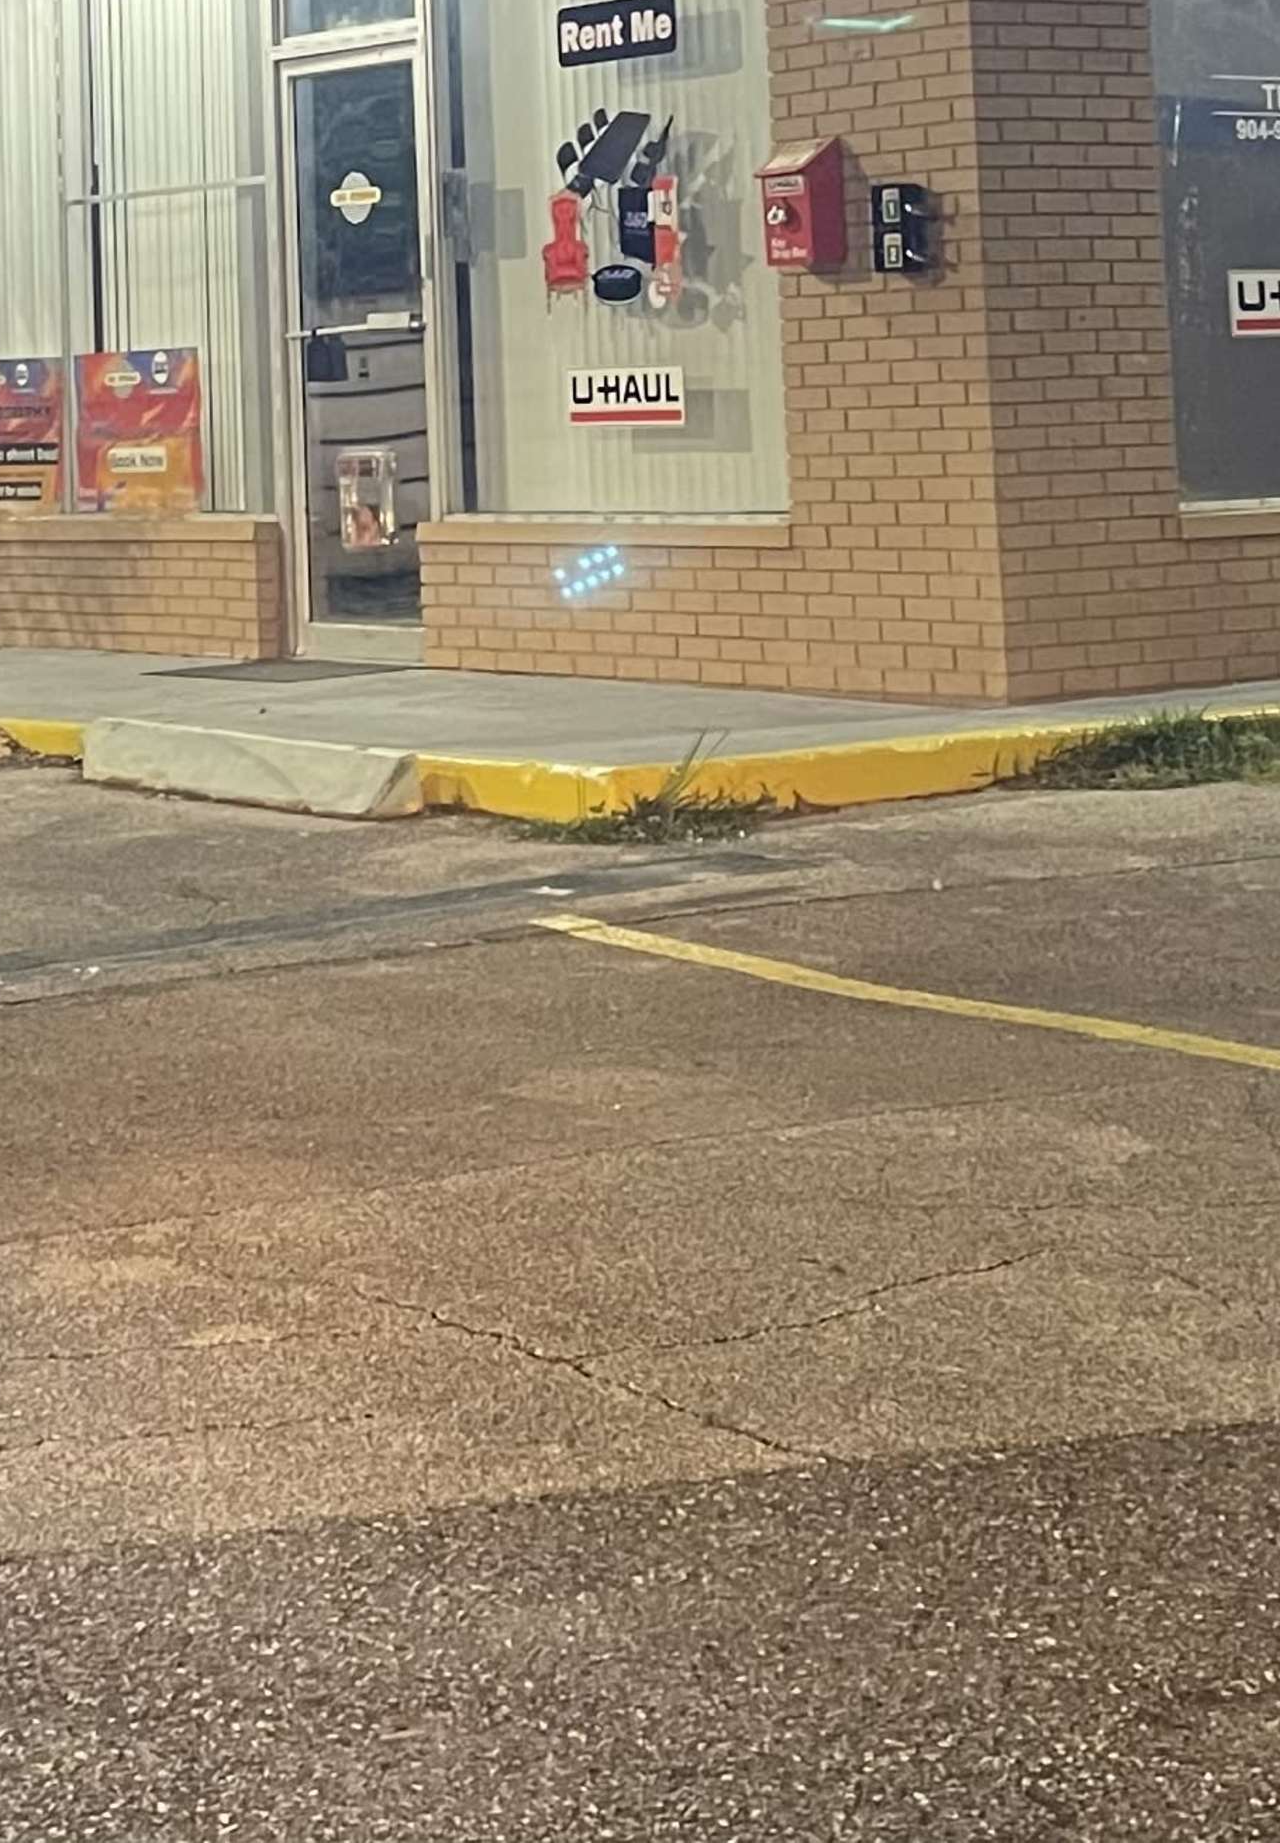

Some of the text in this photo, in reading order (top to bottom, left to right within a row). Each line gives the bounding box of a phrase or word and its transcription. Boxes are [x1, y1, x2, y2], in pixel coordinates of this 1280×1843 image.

[560, 9, 673, 54] Rent Me
[572, 373, 679, 404] U-HAUL
